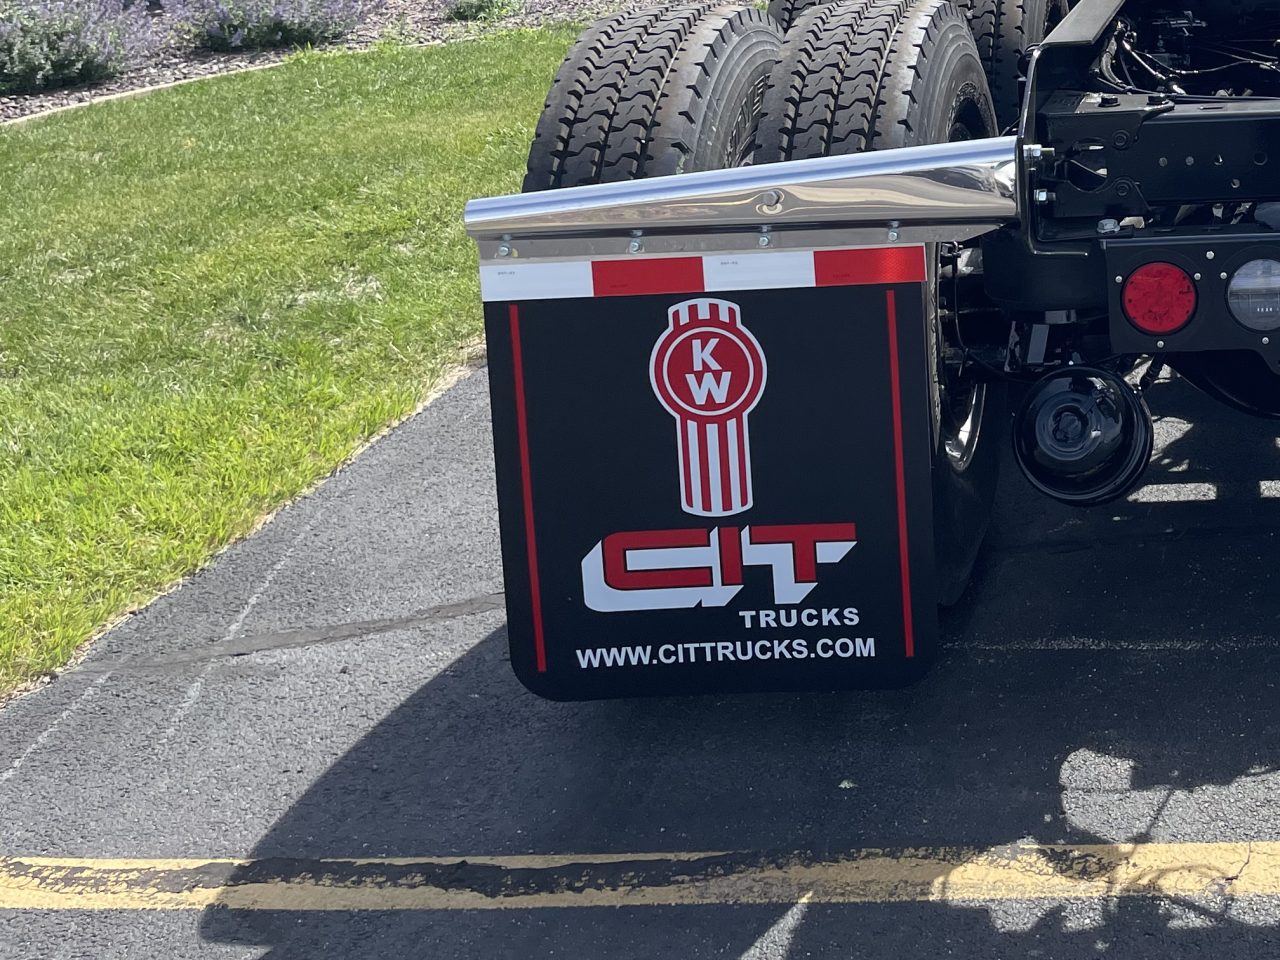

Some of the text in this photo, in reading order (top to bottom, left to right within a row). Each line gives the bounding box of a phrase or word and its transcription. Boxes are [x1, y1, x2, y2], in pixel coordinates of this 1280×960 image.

[581, 522, 858, 613] CIT
[738, 607, 860, 628] TRUCKS
[575, 637, 876, 669] WWW.CITTRUCKS.COM
